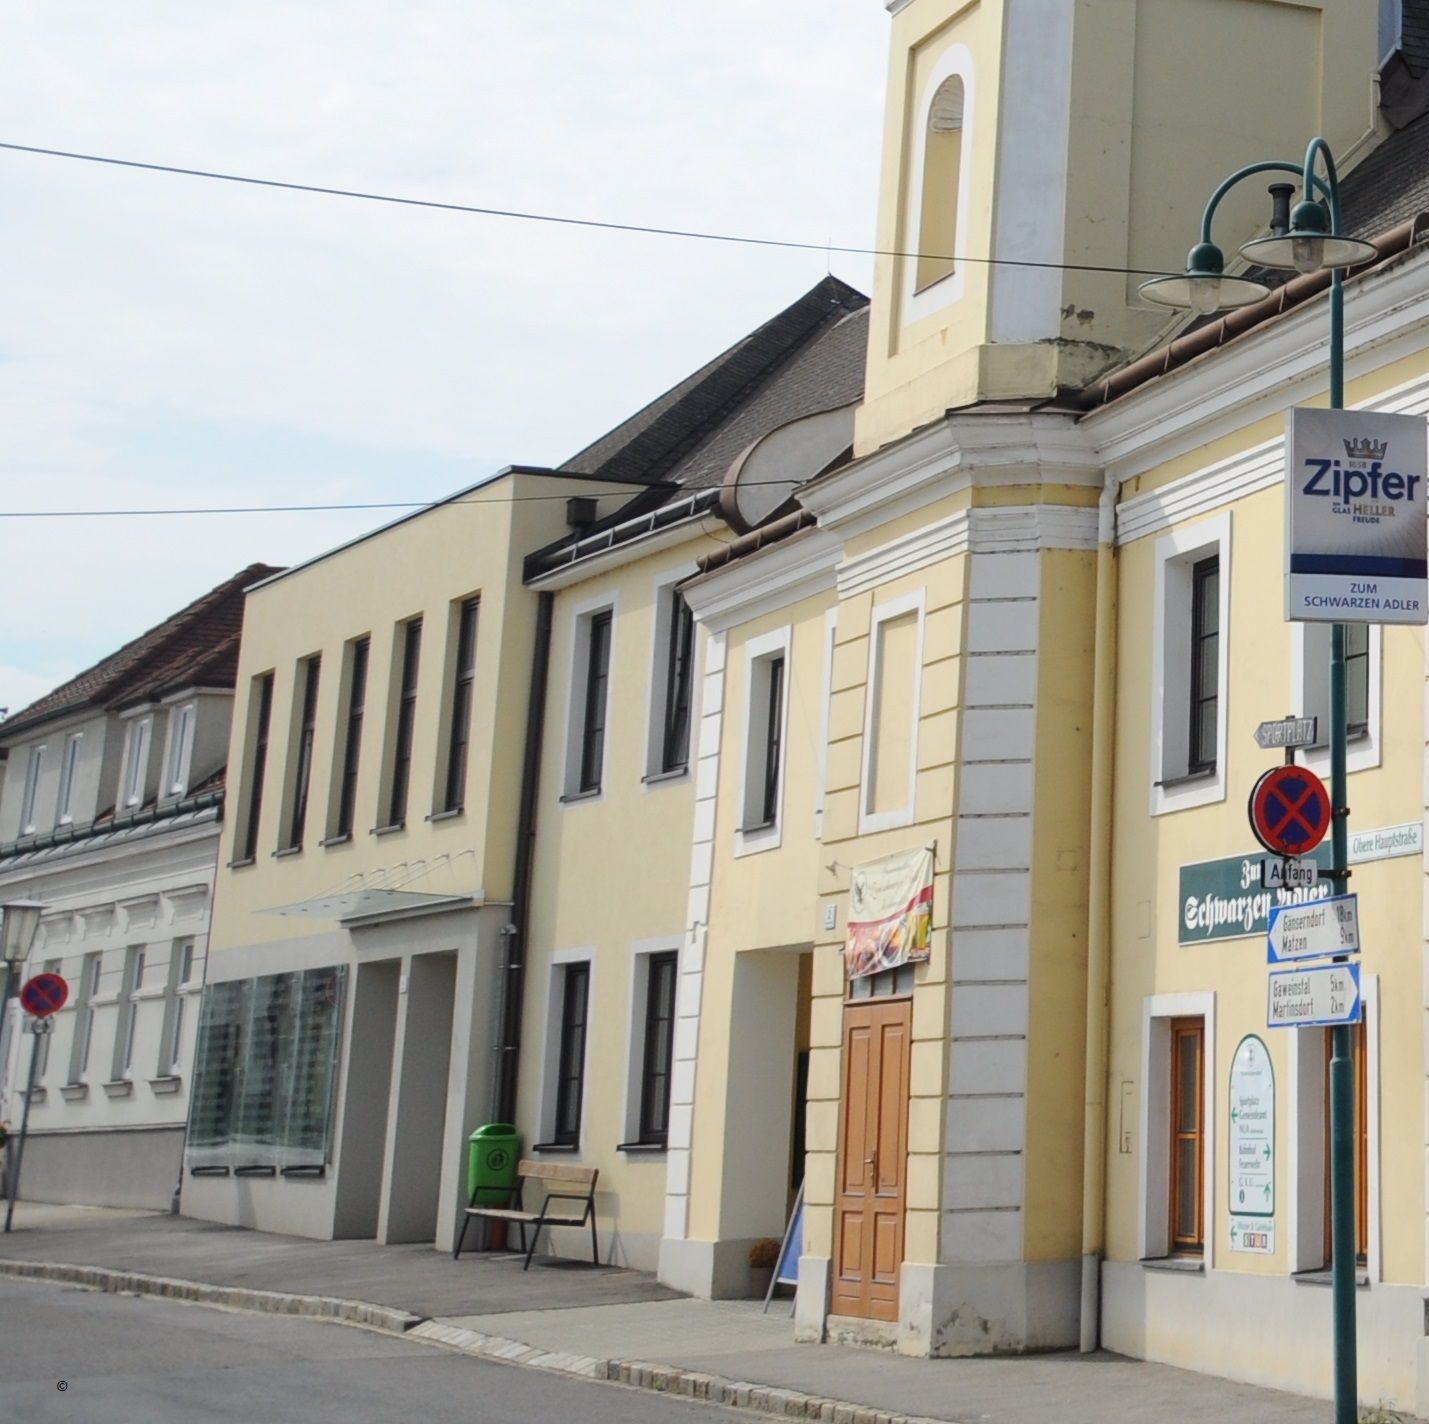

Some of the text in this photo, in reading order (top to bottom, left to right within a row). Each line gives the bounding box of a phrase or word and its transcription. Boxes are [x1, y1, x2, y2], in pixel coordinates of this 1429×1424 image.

[1302, 458, 1421, 505] Zipfer
[1353, 504, 1395, 517] HELLER
[1350, 582, 1378, 594] ZUM
[1304, 595, 1420, 611] SCHWARZEN ADLER
[1262, 719, 1314, 745] SPORTPLATZ
[1353, 827, 1418, 855] Obere Hauptstraße
[1184, 893, 1271, 936] Schwarzen
[1283, 909, 1326, 932] Gänserndorf
[1282, 936, 1307, 953] Matzen
[1273, 977, 1311, 998] Gaweinstal
[1272, 998, 1314, 1018] Martinsdorf
